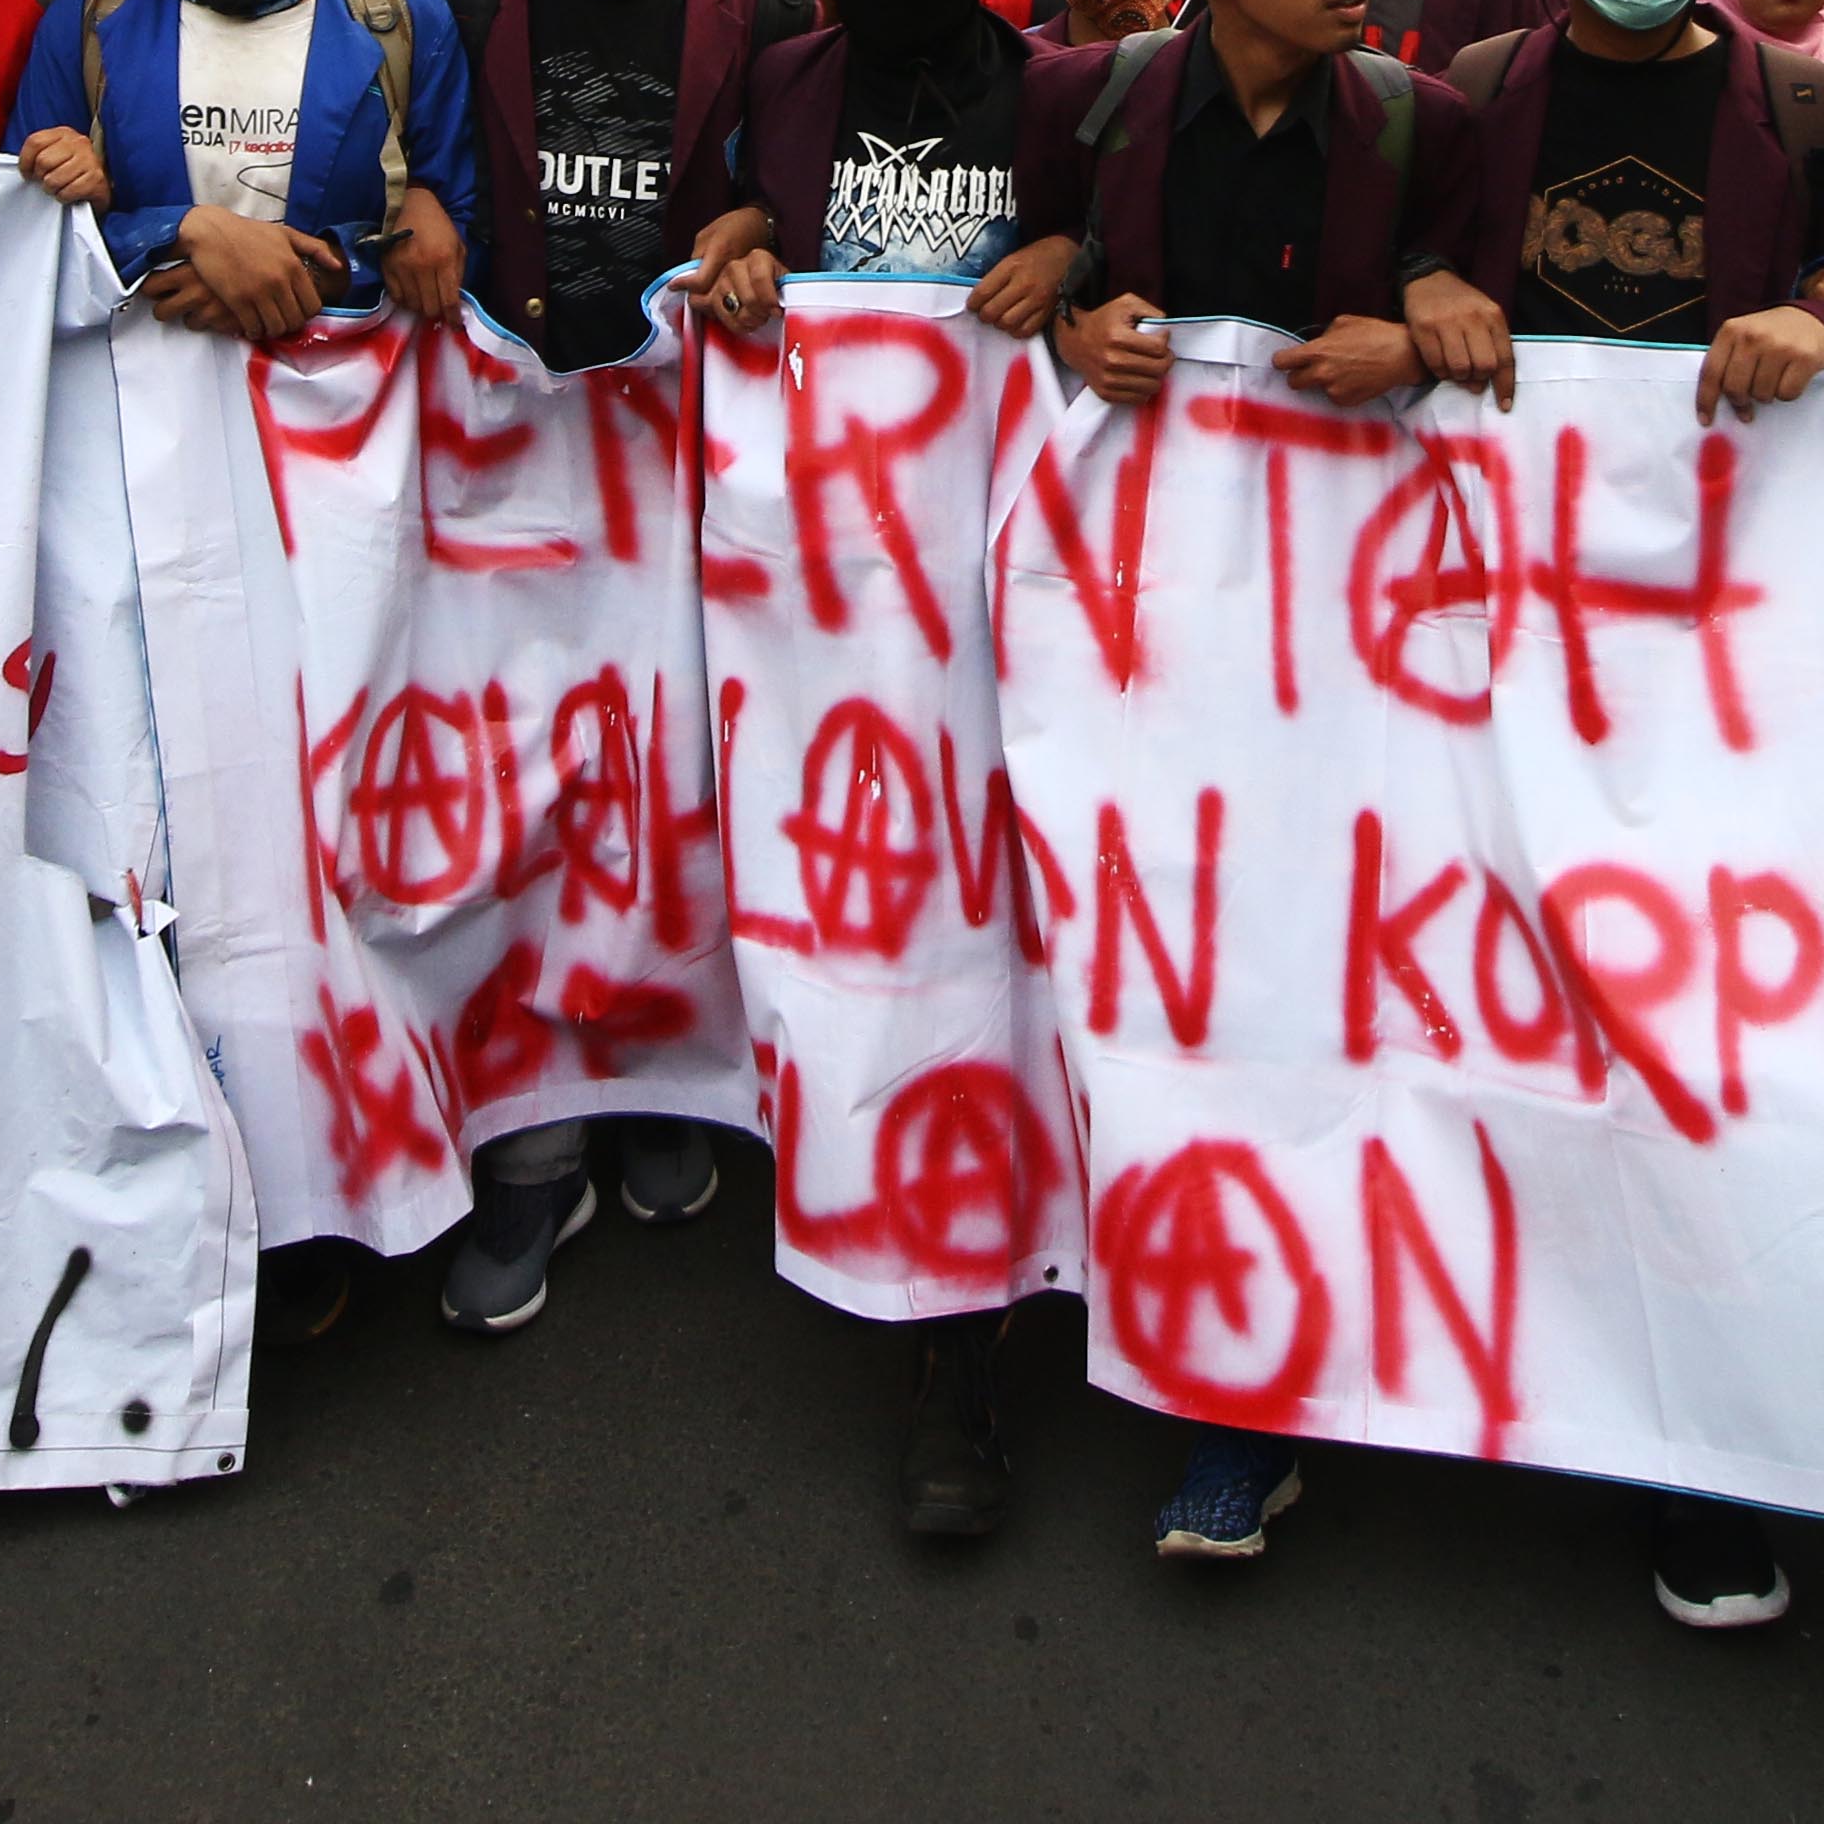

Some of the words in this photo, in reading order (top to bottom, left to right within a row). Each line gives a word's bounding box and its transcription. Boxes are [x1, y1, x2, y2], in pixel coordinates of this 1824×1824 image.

[180, 104, 226, 129] en
[229, 107, 301, 135] MIRA
[181, 129, 226, 147] GDJA
[547, 201, 625, 220] MCMXCVI
